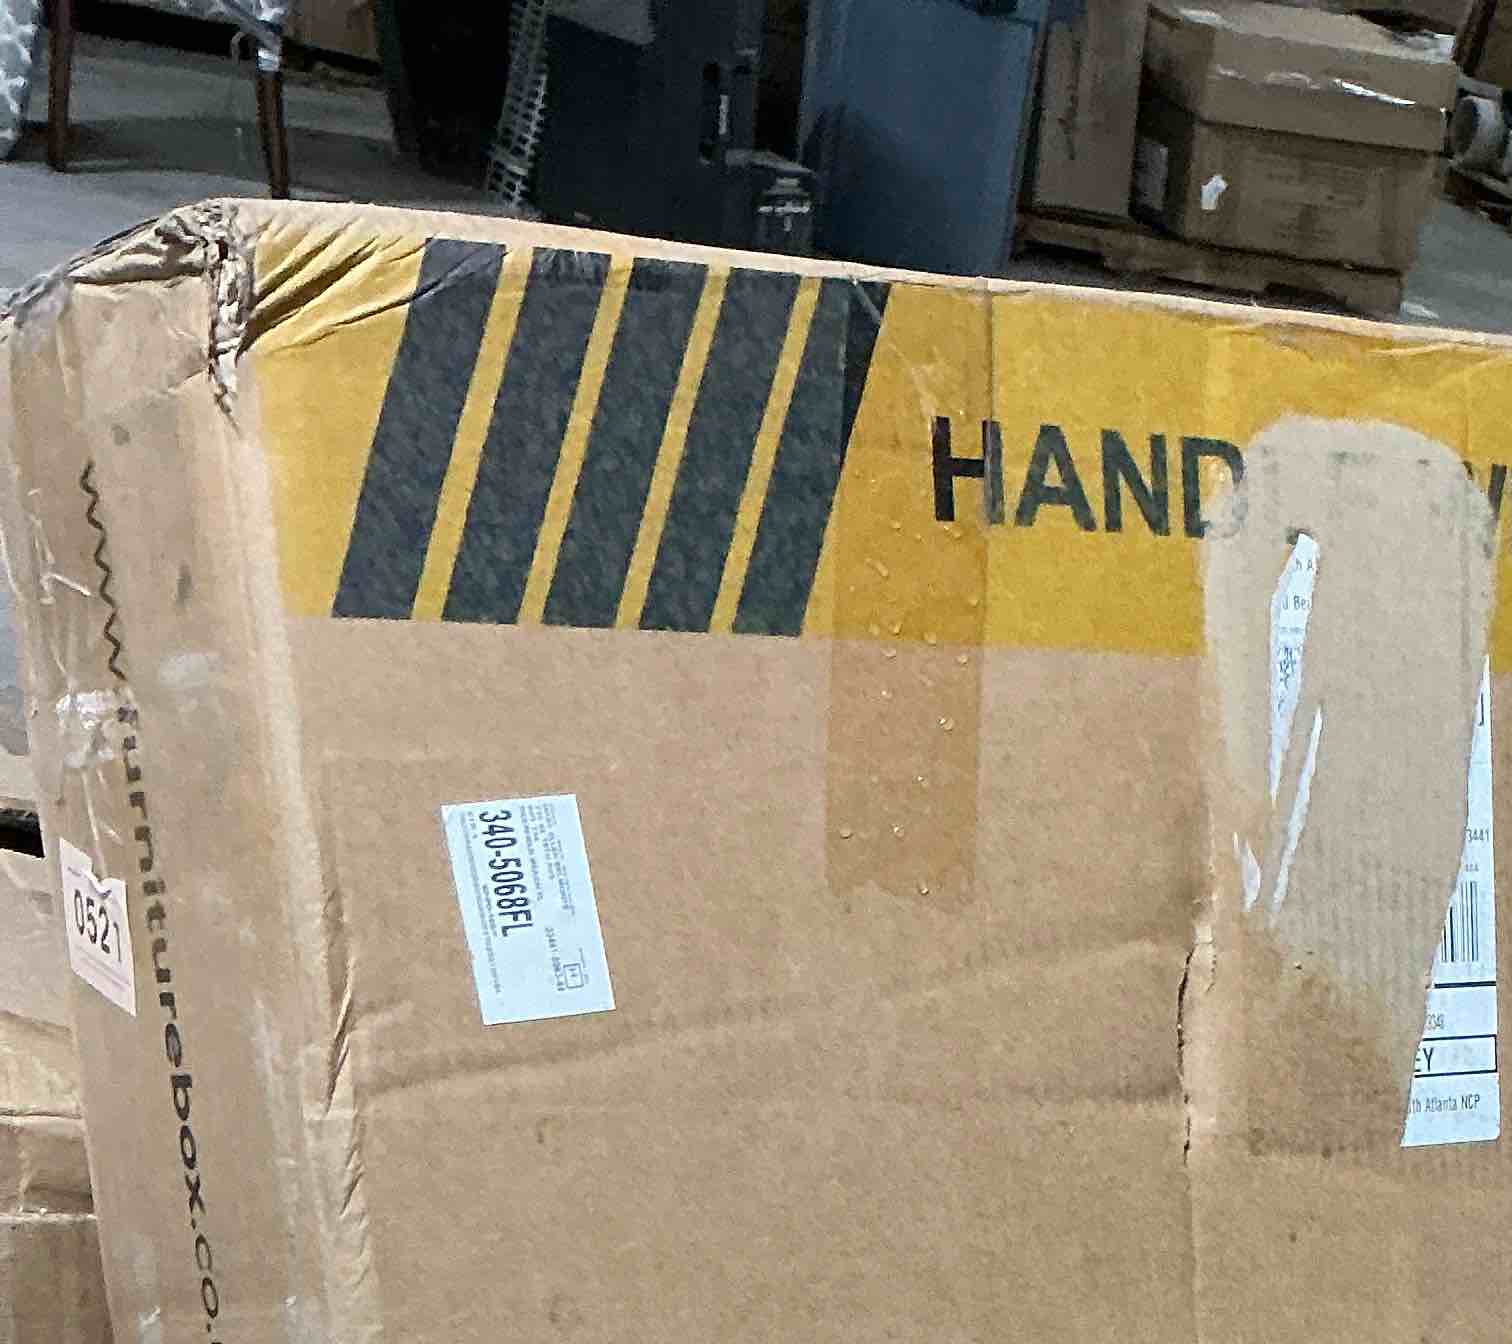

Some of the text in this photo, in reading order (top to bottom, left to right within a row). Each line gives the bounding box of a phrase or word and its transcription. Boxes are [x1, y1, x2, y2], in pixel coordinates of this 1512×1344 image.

[932, 414, 1248, 541] HAND
[74, 888, 122, 965] 0521
[479, 808, 534, 938] 340-5068FL
